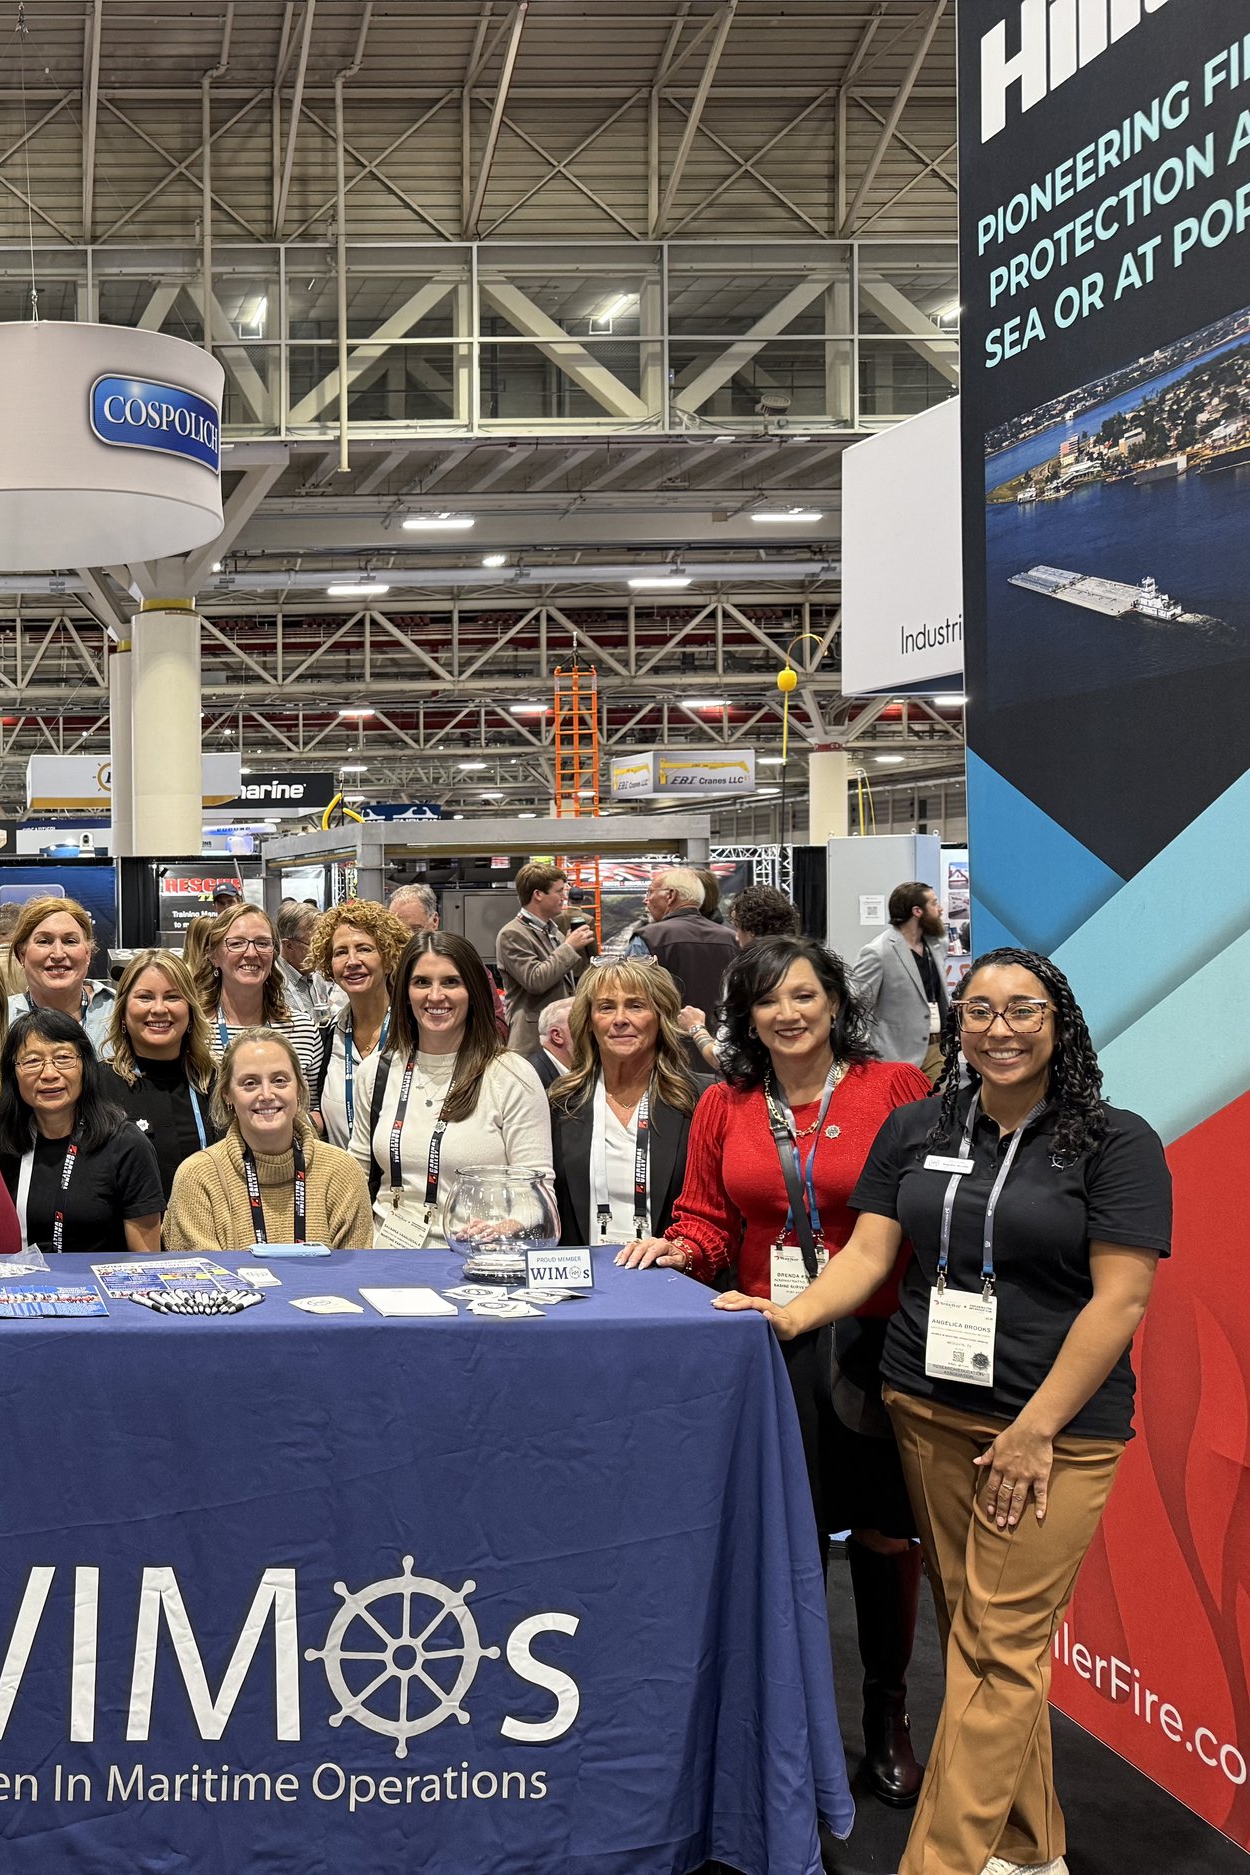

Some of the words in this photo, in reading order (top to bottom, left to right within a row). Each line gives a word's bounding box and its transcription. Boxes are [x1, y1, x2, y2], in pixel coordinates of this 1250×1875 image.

[978, 80, 1190, 257] PIONEERING
[990, 132, 1214, 308] PROTECTION
[984, 307, 1046, 368] SEA
[1054, 272, 1104, 330] OR
[1113, 235, 1162, 301] AT
[103, 395, 219, 455] COSPOLICH
[699, 777, 727, 785] Cranes
[728, 776, 744, 784] LLC
[172, 911, 200, 919] Training
[931, 1319, 963, 1329] ANGELICA
[964, 1323, 991, 1334] BROOKS
[54, 1764, 91, 1801] In
[106, 1763, 300, 1803] Maritime
[311, 1761, 549, 1812] Operations
